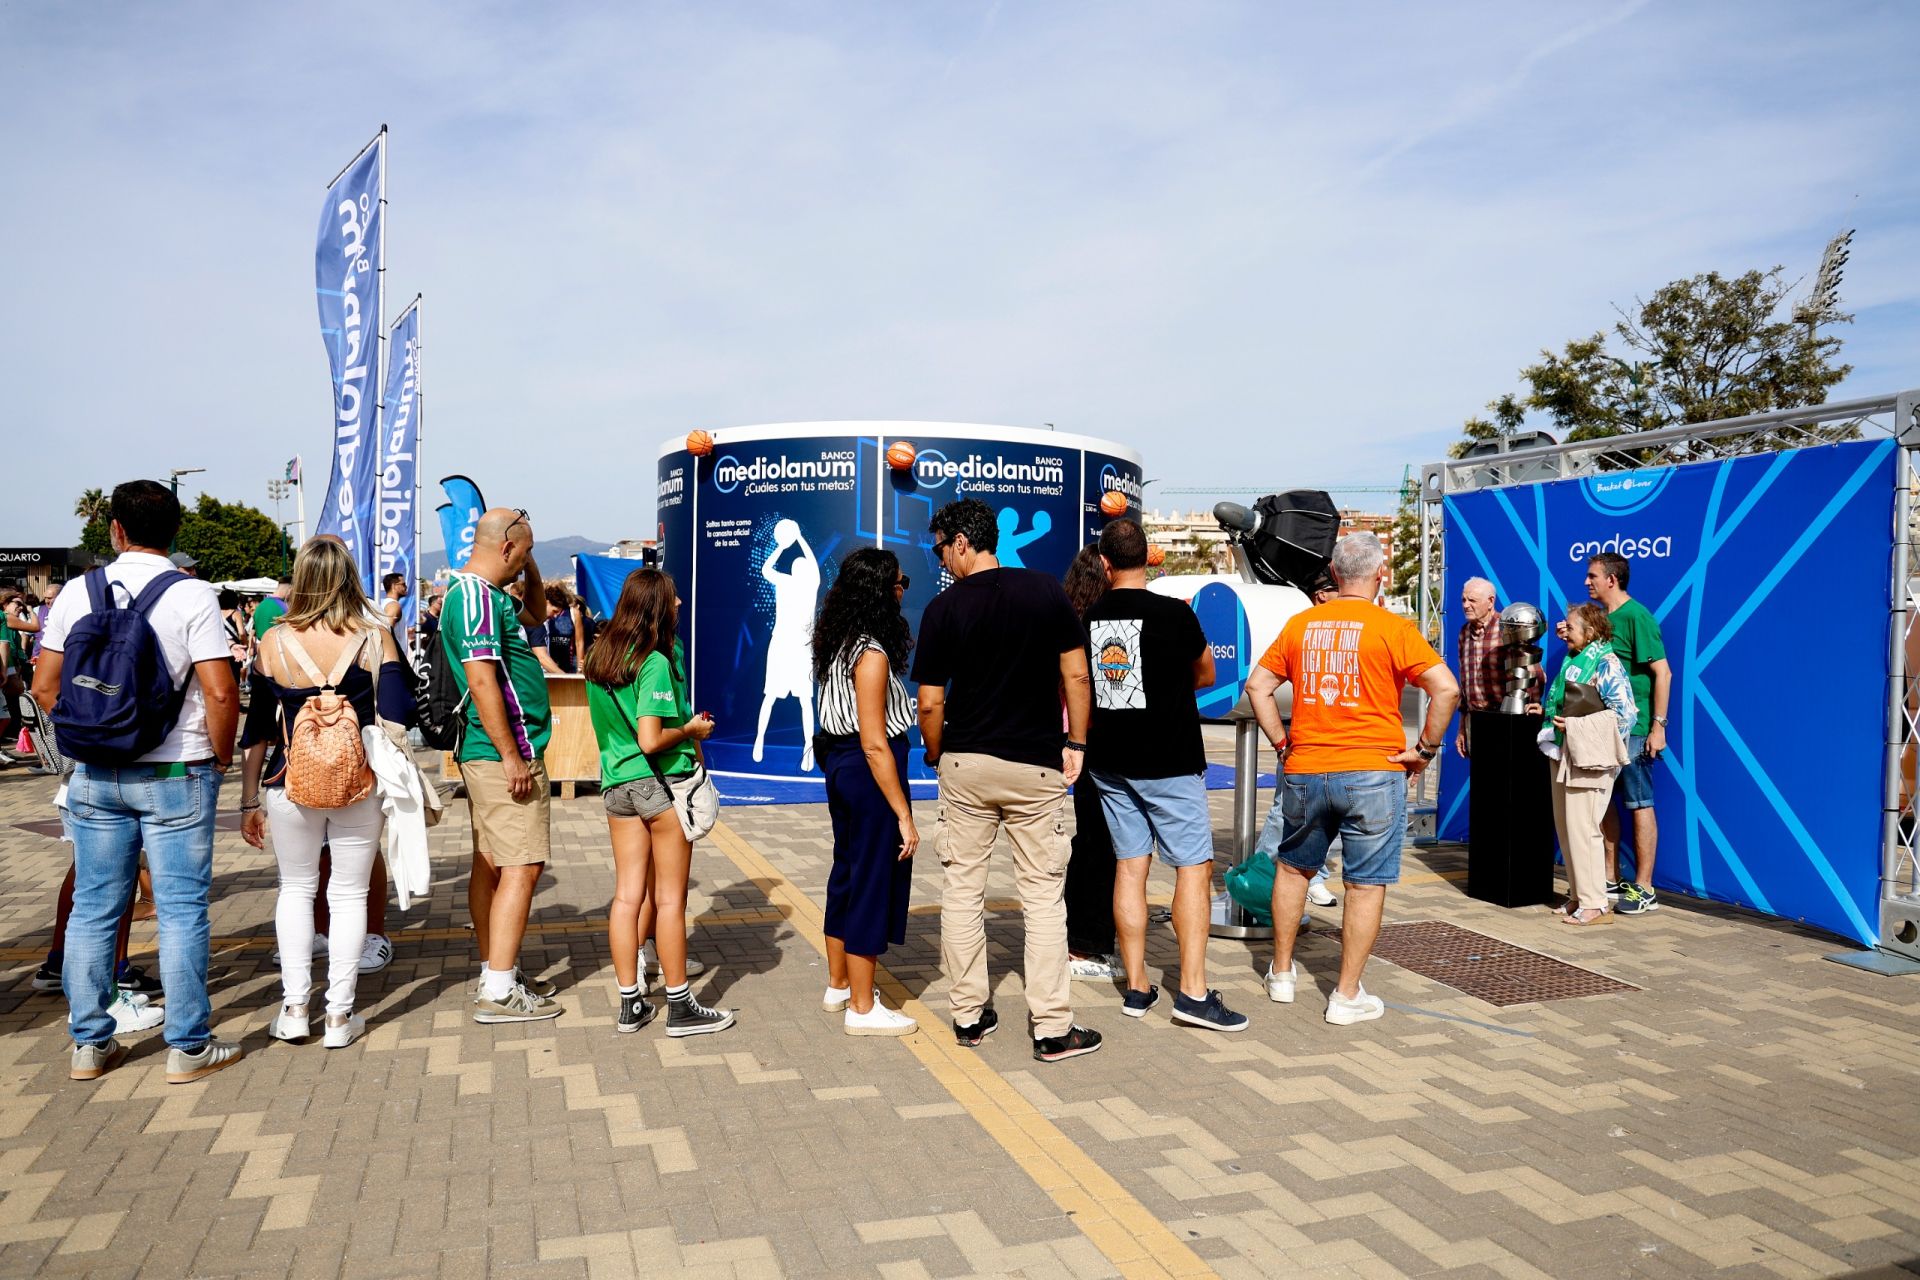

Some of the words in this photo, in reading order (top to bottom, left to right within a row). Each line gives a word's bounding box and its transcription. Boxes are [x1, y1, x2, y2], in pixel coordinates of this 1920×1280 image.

[820, 451, 855, 461] BANCO
[1035, 456, 1063, 467] BANCO
[719, 455, 856, 483] mediolanum
[919, 454, 1064, 483] mediolanum
[744, 481, 779, 497] ¿Cuáles
[781, 483, 798, 493] son
[800, 481, 816, 492] tus
[818, 479, 855, 492] metas?
[955, 480, 996, 495] ¿Cuáles
[998, 483, 1015, 494] son
[1017, 483, 1031, 494] tus
[1033, 485, 1064, 497] metas?
[715, 539, 721, 547] de
[1569, 532, 1672, 562] endesa
[1302, 629, 1337, 650] PLAYOFF
[1338, 629, 1361, 651] FINAL
[1210, 641, 1235, 659] desa
[1302, 650, 1320, 673] LIGA
[1324, 651, 1359, 674] ENDESA
